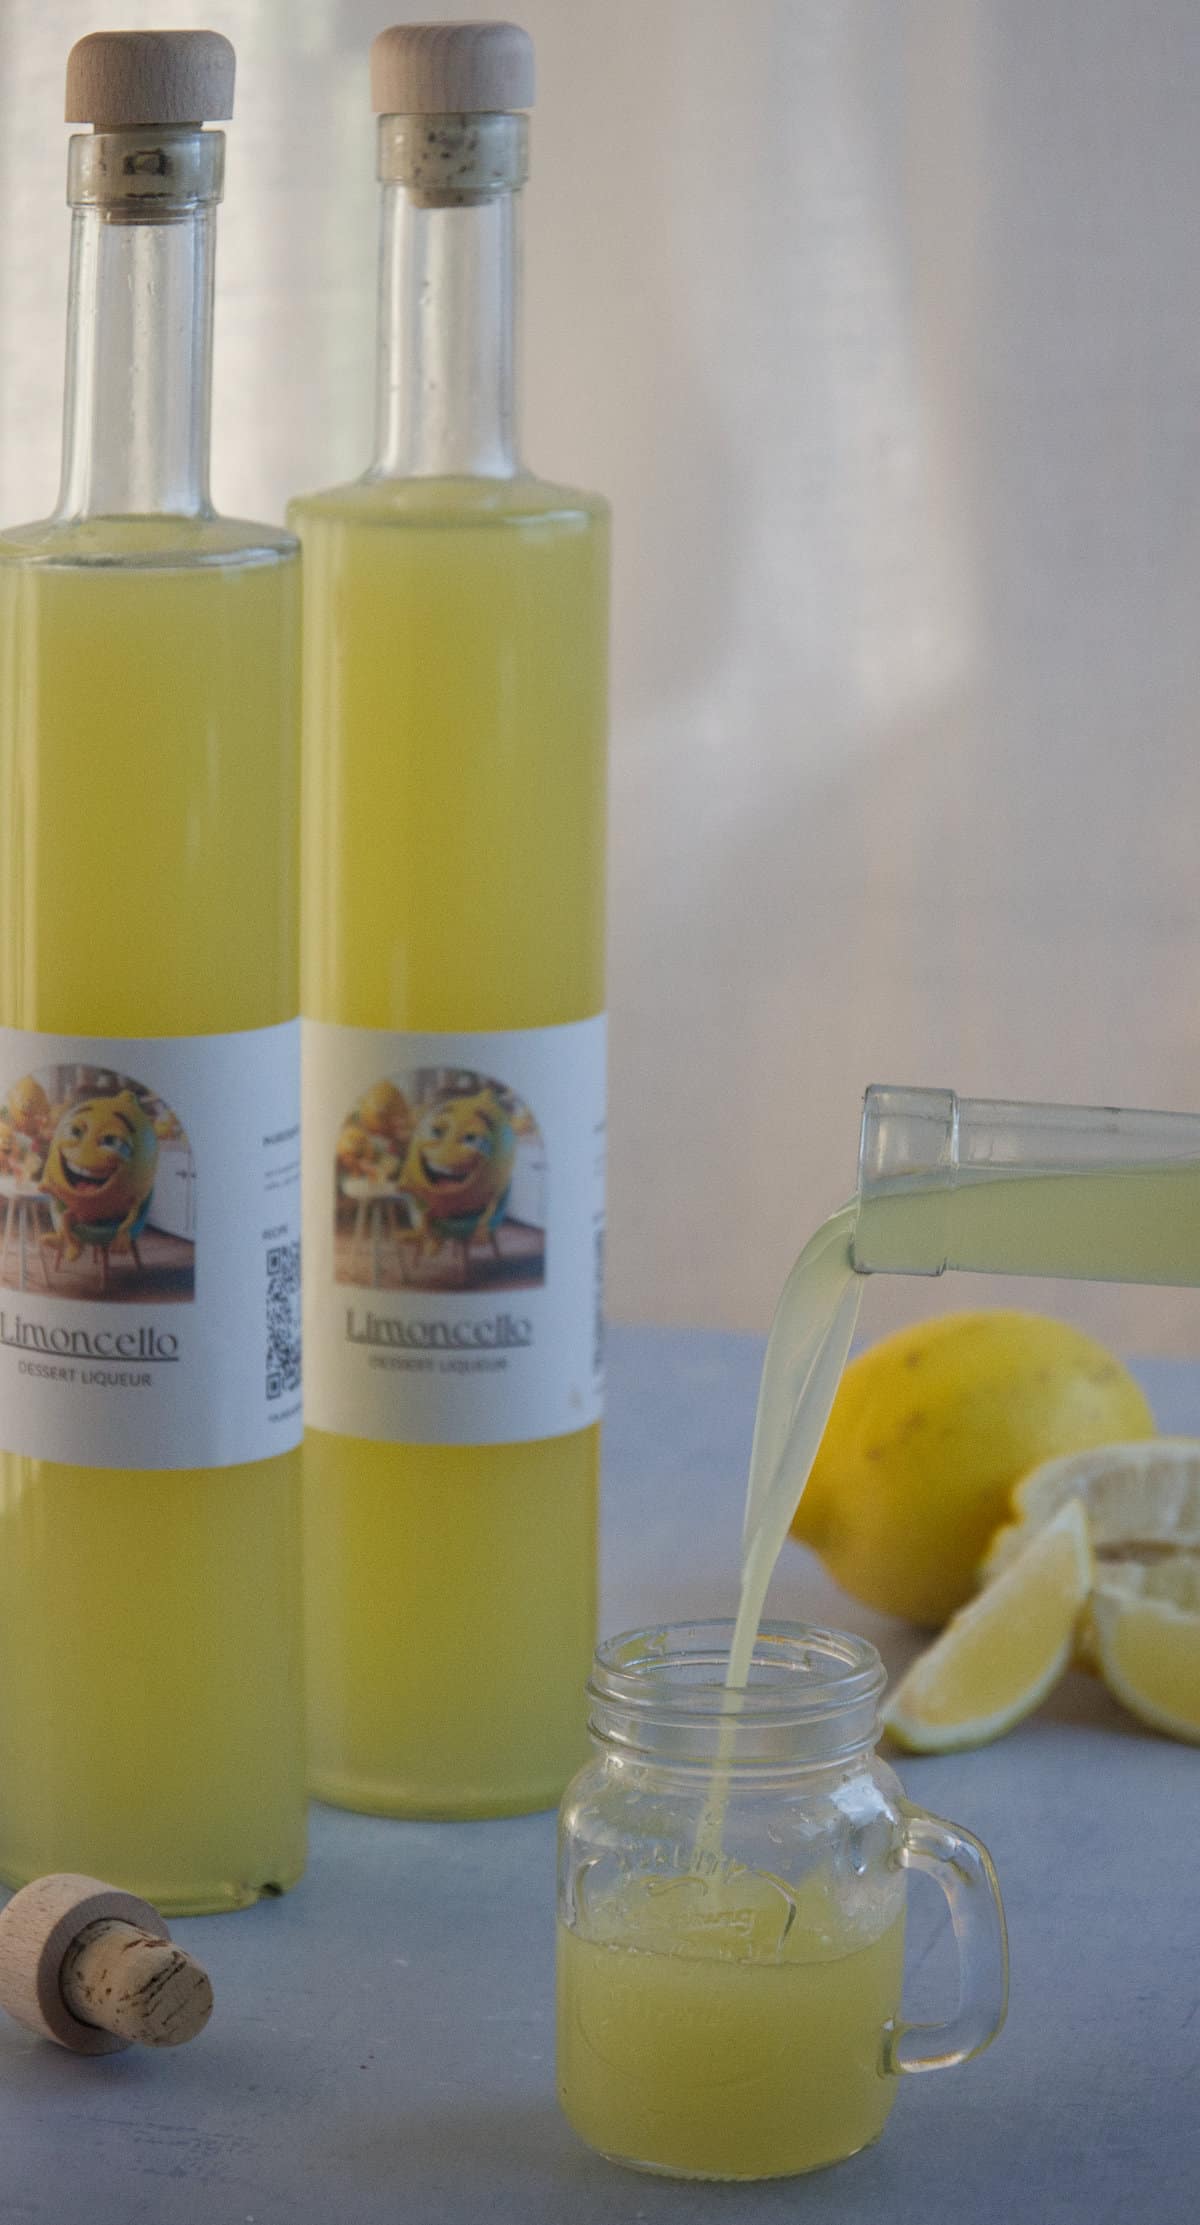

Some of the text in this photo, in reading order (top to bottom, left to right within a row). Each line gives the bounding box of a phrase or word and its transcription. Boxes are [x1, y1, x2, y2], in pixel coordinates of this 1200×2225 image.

[0, 1311, 178, 1359] Limoncello
[346, 1308, 533, 1348] Limoncello
[18, 1360, 153, 1387] DESSERT LIQUEUR
